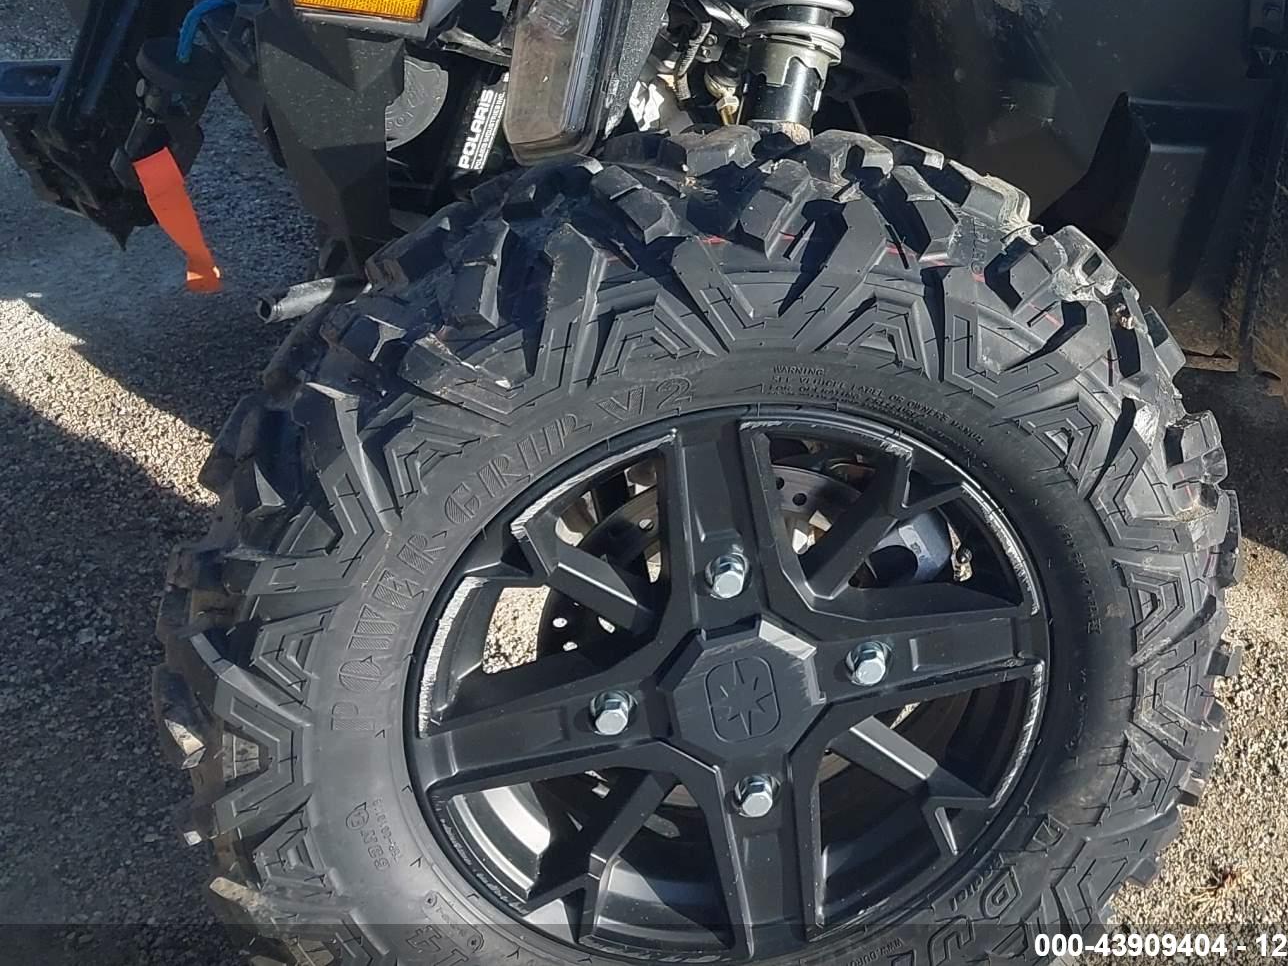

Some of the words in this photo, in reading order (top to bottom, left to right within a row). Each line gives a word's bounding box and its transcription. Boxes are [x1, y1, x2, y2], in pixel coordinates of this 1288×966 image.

[457, 89, 494, 169] POLARIS
[331, 534, 448, 731] POWER
[443, 413, 594, 525] GRIP
[597, 379, 695, 421] V2
